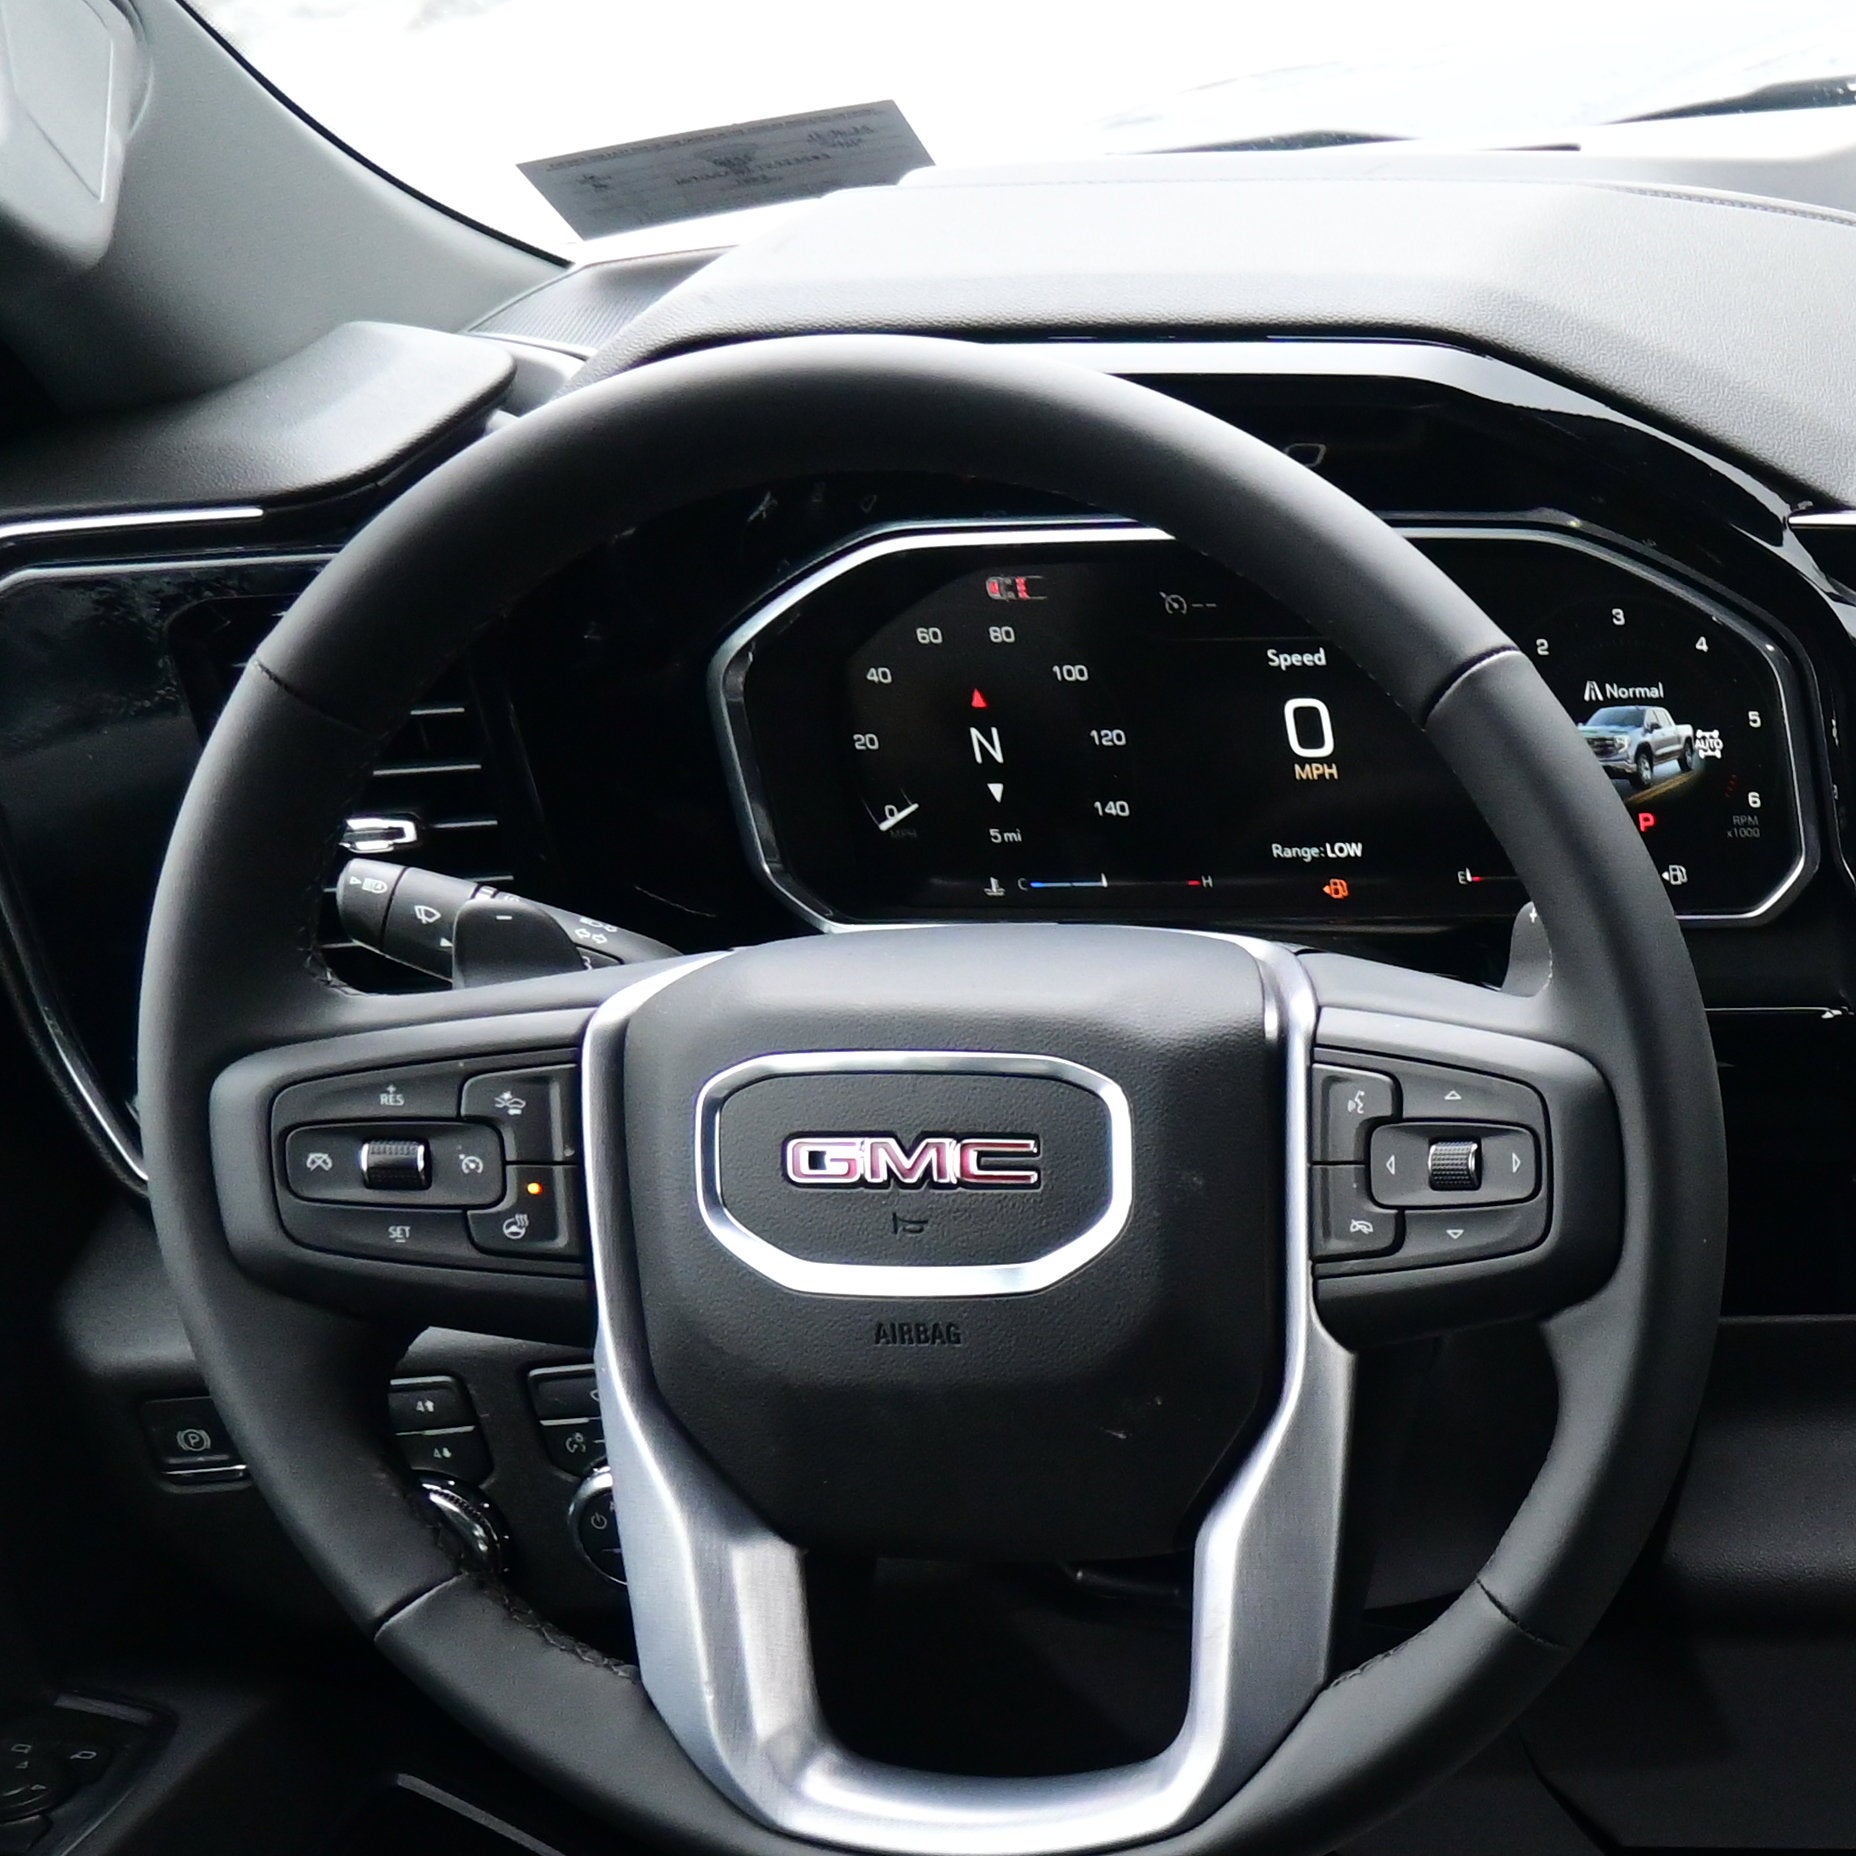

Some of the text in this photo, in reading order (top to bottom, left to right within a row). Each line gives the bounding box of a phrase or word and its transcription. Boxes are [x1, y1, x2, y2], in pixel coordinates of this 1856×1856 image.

[1612, 608, 1625, 626] 3
[916, 627, 943, 645] 60
[989, 626, 1015, 643] 80
[1536, 638, 1549, 656] 2
[1695, 635, 1709, 653] 4
[1267, 647, 1327, 670] Speed
[866, 667, 892, 684] 40
[1052, 664, 1088, 682] 100
[1605, 681, 1665, 700] Normal
[1283, 697, 1335, 758] 0
[1748, 710, 1761, 729] 5
[853, 733, 879, 750] 20
[969, 726, 1004, 764] N
[1090, 729, 1126, 747] 120
[1695, 738, 1723, 751] AUTO
[1294, 763, 1338, 780] MPH
[1094, 801, 1129, 817] 140
[1747, 791, 1761, 809] 6
[884, 805, 899, 822] 0
[1638, 813, 1654, 831] P
[1732, 815, 1759, 827] RPM
[989, 828, 1022, 843] 5 mi
[1726, 826, 1760, 838] x1000
[1272, 842, 1363, 862] Range: LOW
[1201, 875, 1213, 888] H
[380, 1093, 404, 1106] RES
[787, 1137, 1038, 1184] GMC
[388, 1226, 410, 1239] SET
[874, 1323, 961, 1345] AIRBAG
